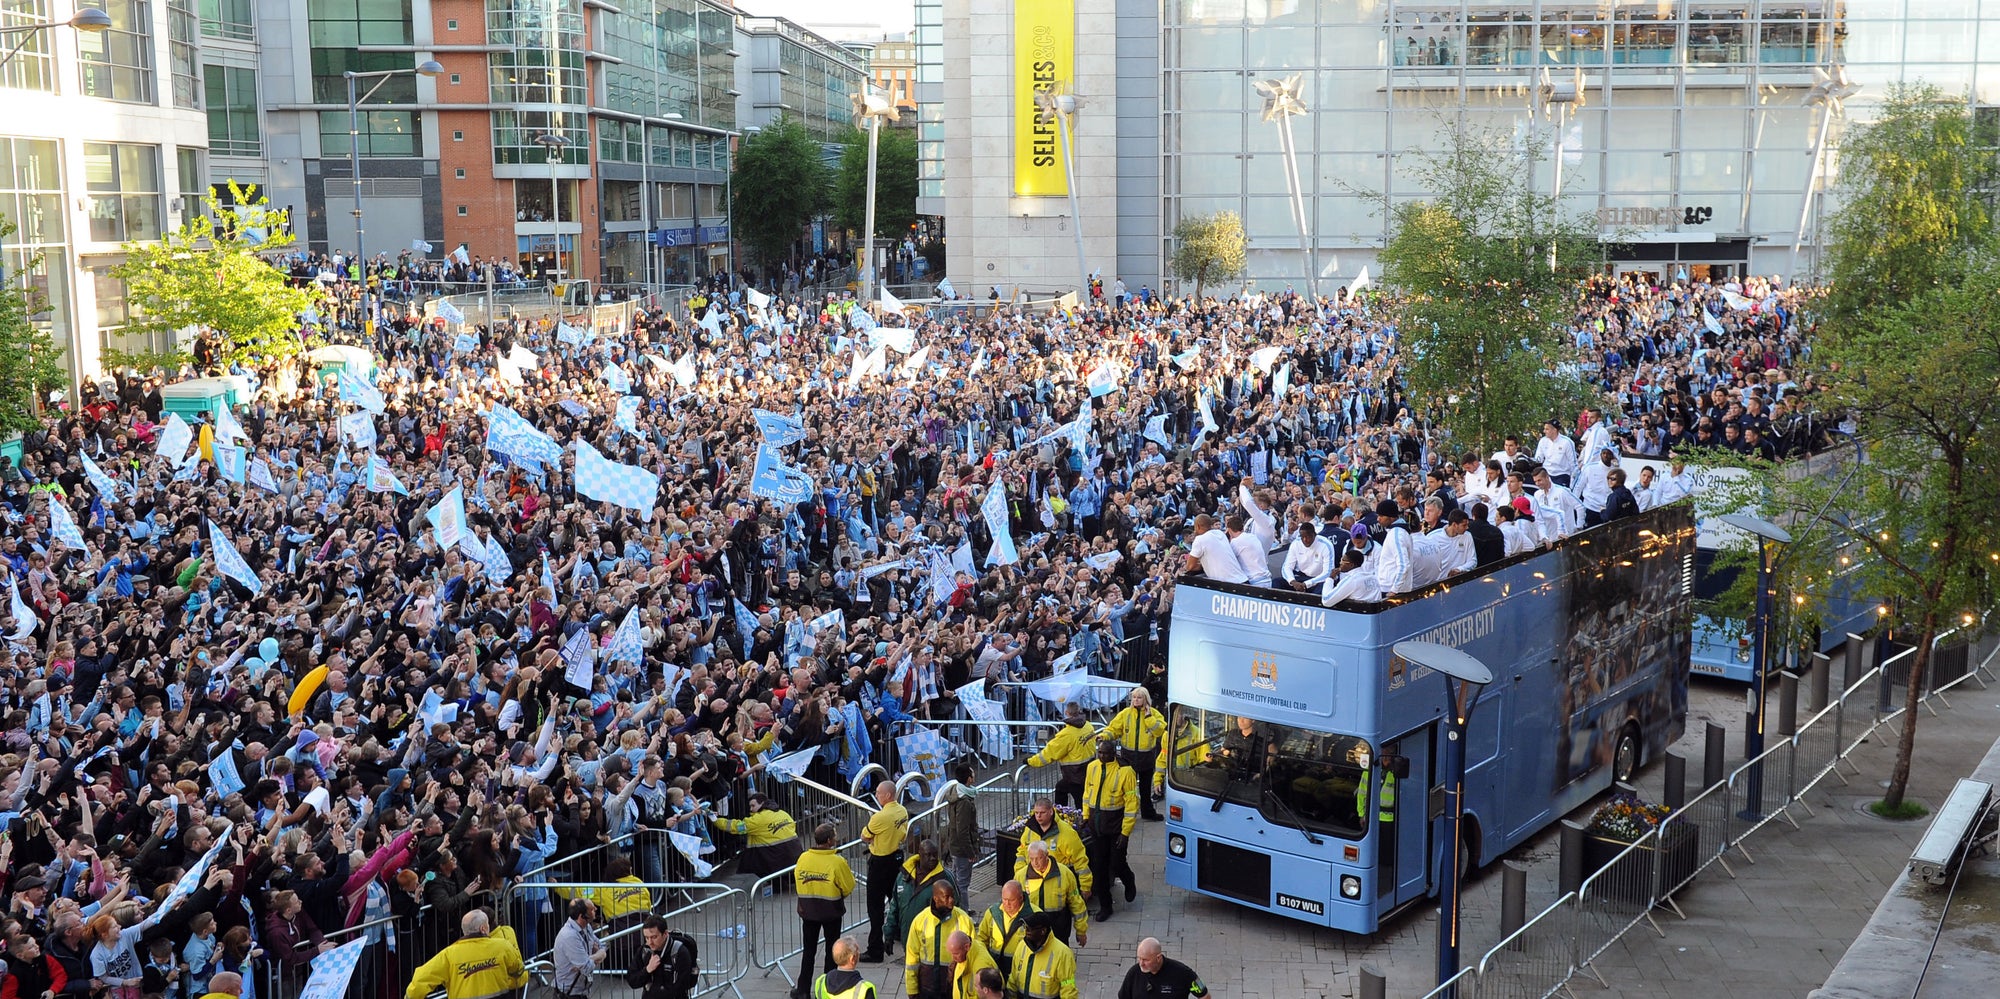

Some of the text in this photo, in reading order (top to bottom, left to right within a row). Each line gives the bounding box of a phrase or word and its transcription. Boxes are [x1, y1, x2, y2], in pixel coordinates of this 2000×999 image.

[1211, 594, 1326, 632] CHAMPIONS 2014
[1475, 606, 1495, 639] CITY
[1221, 688, 1307, 711] MANCHESTER CITY FOOTBALL CLUB
[1280, 896, 1322, 914] B107 WUL
